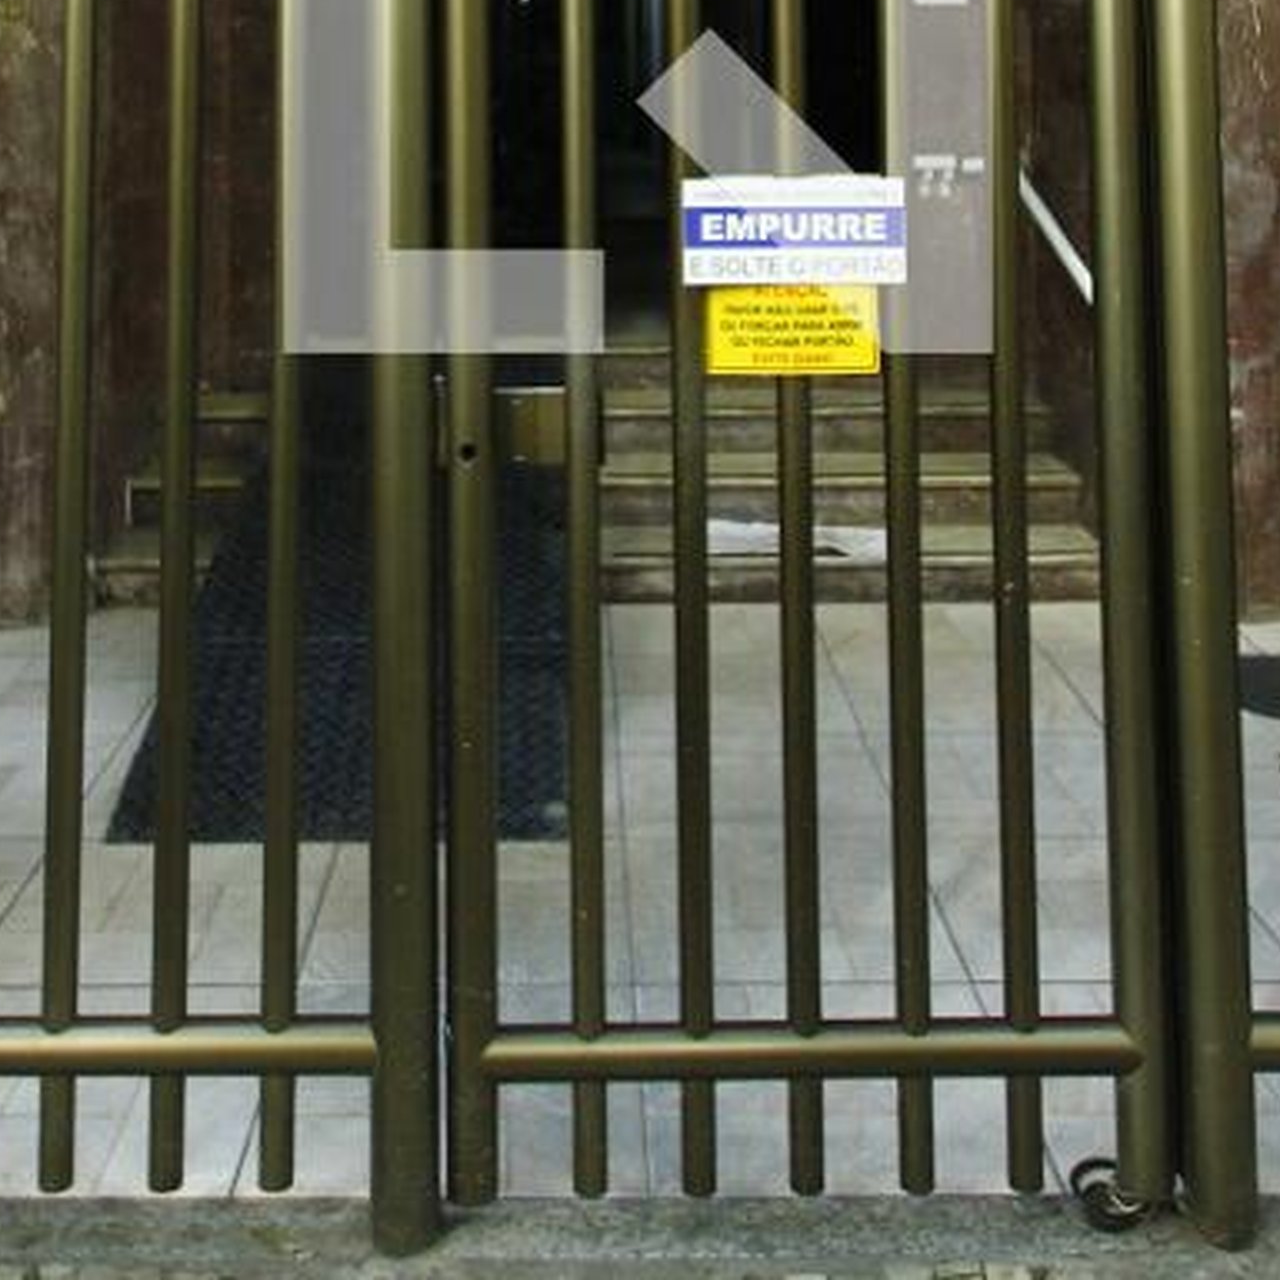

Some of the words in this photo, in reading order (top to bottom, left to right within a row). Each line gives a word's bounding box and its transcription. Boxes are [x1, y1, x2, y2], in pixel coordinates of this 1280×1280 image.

[701, 214, 888, 241] EMPURRE
[690, 256, 703, 278] E
[712, 256, 783, 278] SOLTE
